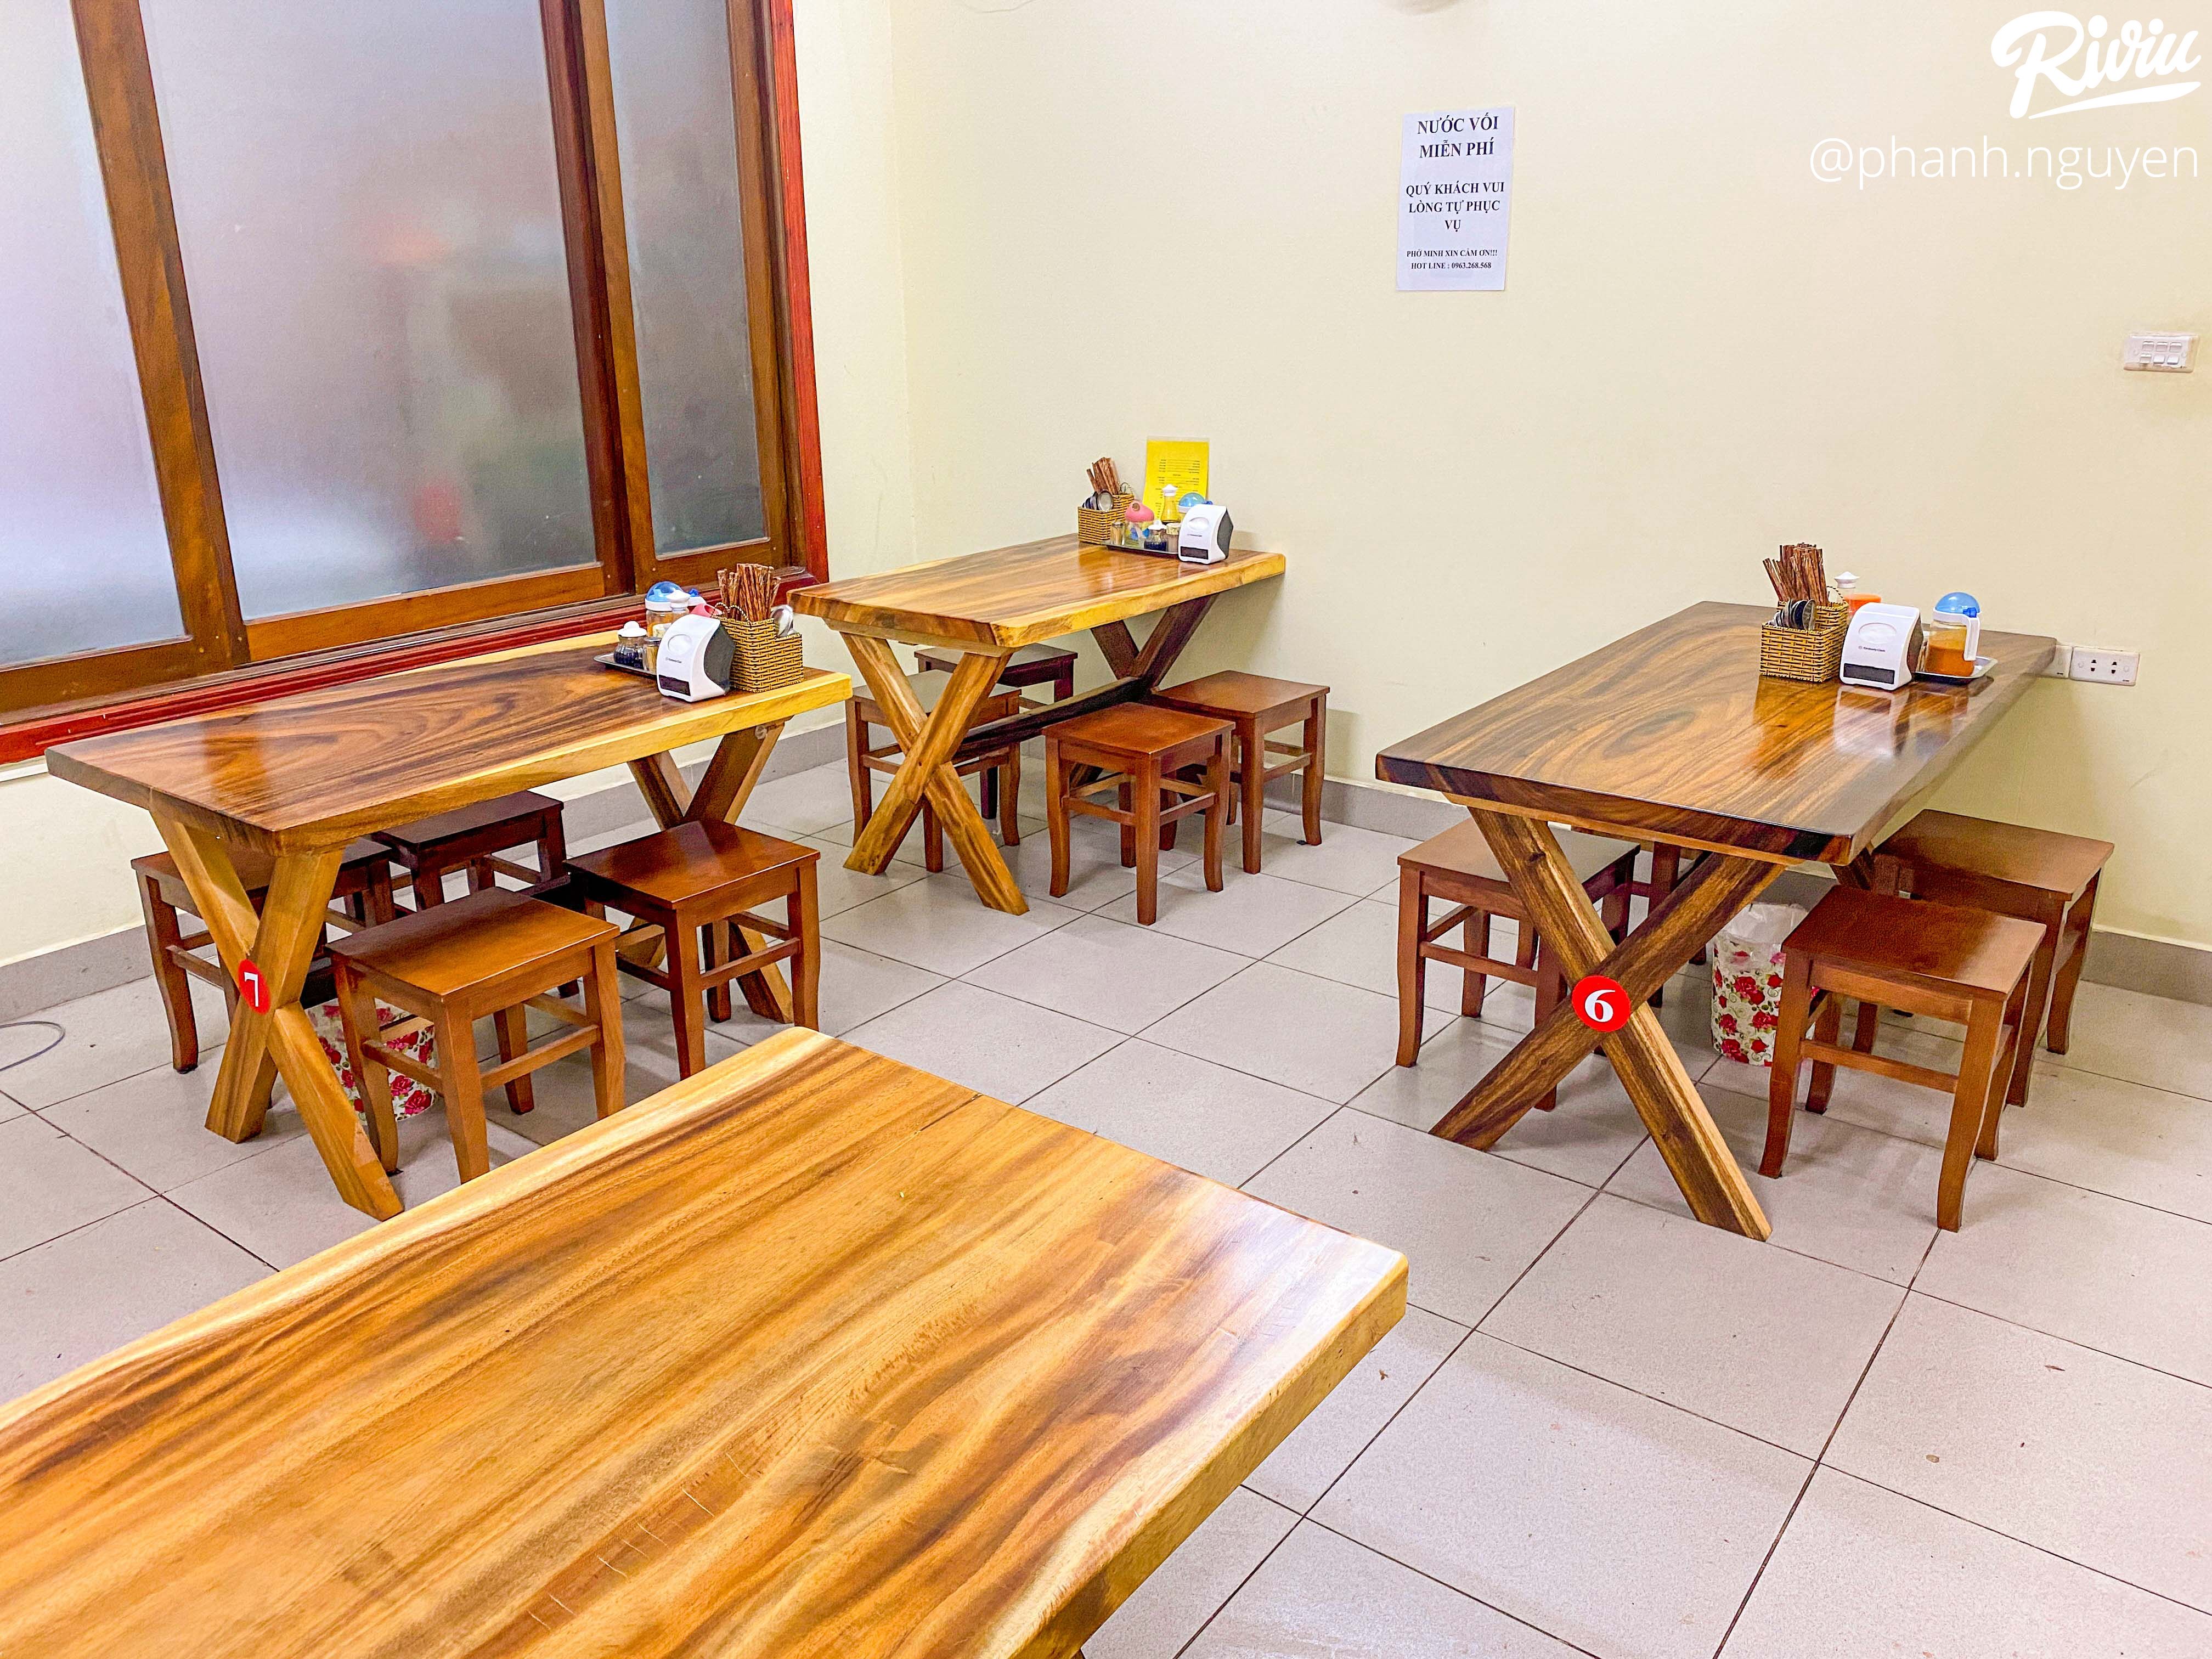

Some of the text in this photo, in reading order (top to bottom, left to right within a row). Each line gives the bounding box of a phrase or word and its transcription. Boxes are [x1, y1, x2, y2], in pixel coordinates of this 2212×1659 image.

[1417, 112, 1499, 134] NƯỚC VỐI
[1419, 137, 1495, 159] MIỄN PHÍ
[1406, 180, 1505, 198] QUÝ KHÁCH VUI
[1408, 199, 1500, 214] LÒNG TỰ PHỤC
[1444, 219, 1461, 232] VỤ
[244, 971, 259, 1007] 7
[1584, 989, 1616, 1023] 6
